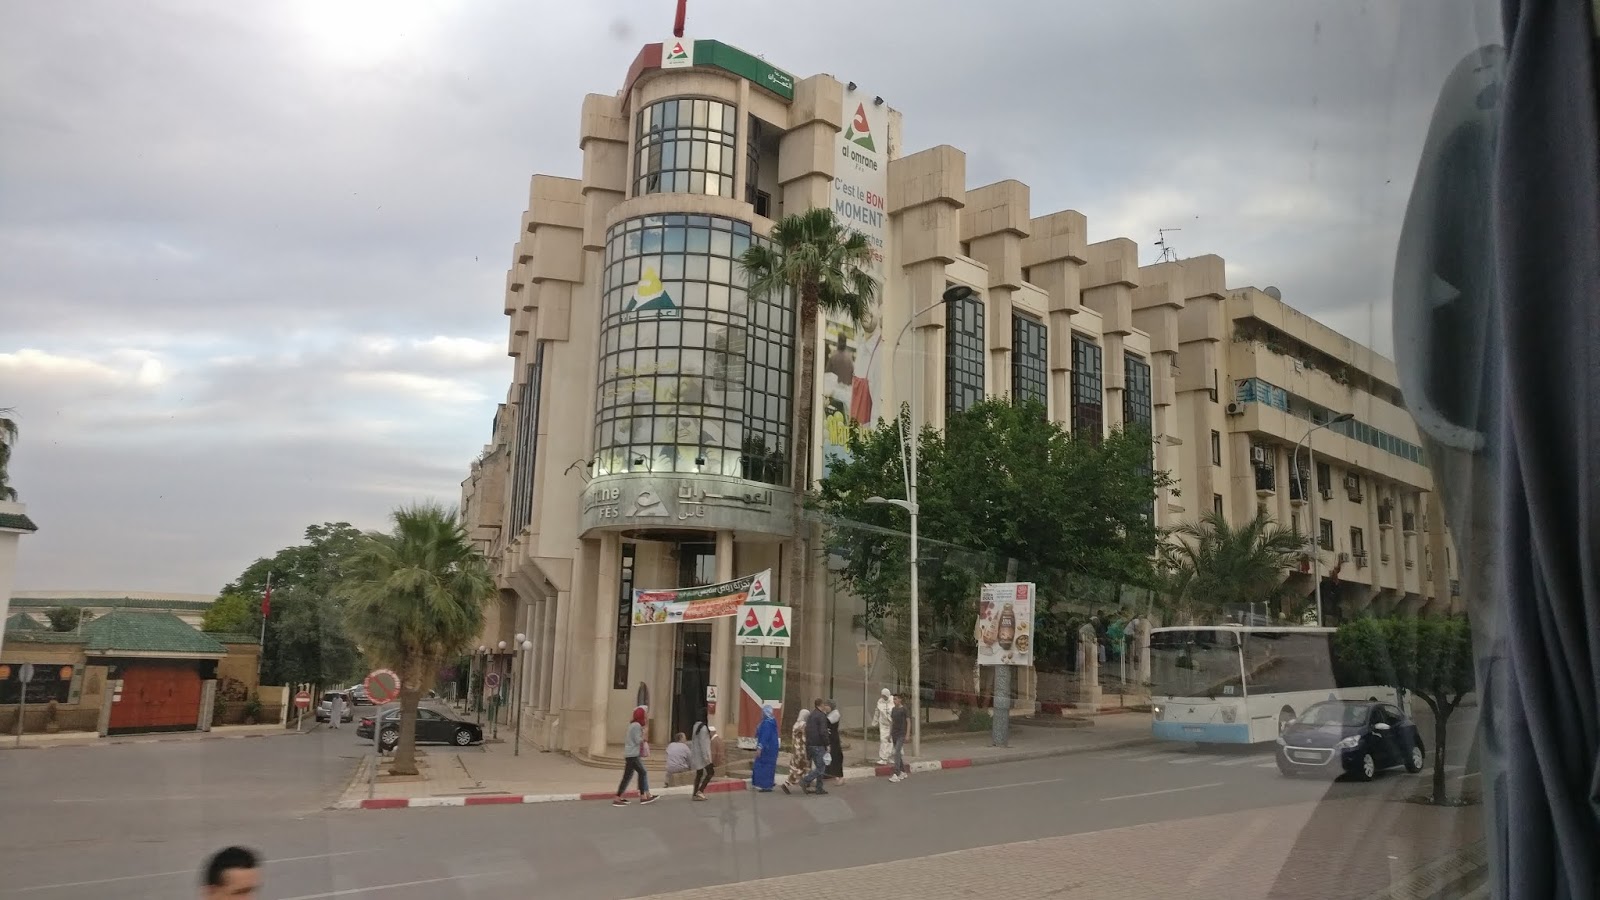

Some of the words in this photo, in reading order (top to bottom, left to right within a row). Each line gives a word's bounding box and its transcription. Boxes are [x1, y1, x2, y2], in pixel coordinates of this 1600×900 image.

[842, 145, 849, 157] al
[851, 150, 878, 171] omrane
[856, 186, 865, 201] le
[866, 190, 884, 211] BON
[835, 198, 883, 229] MOMENT
[678, 480, 772, 506] العمران
[678, 505, 704, 520] فاس
